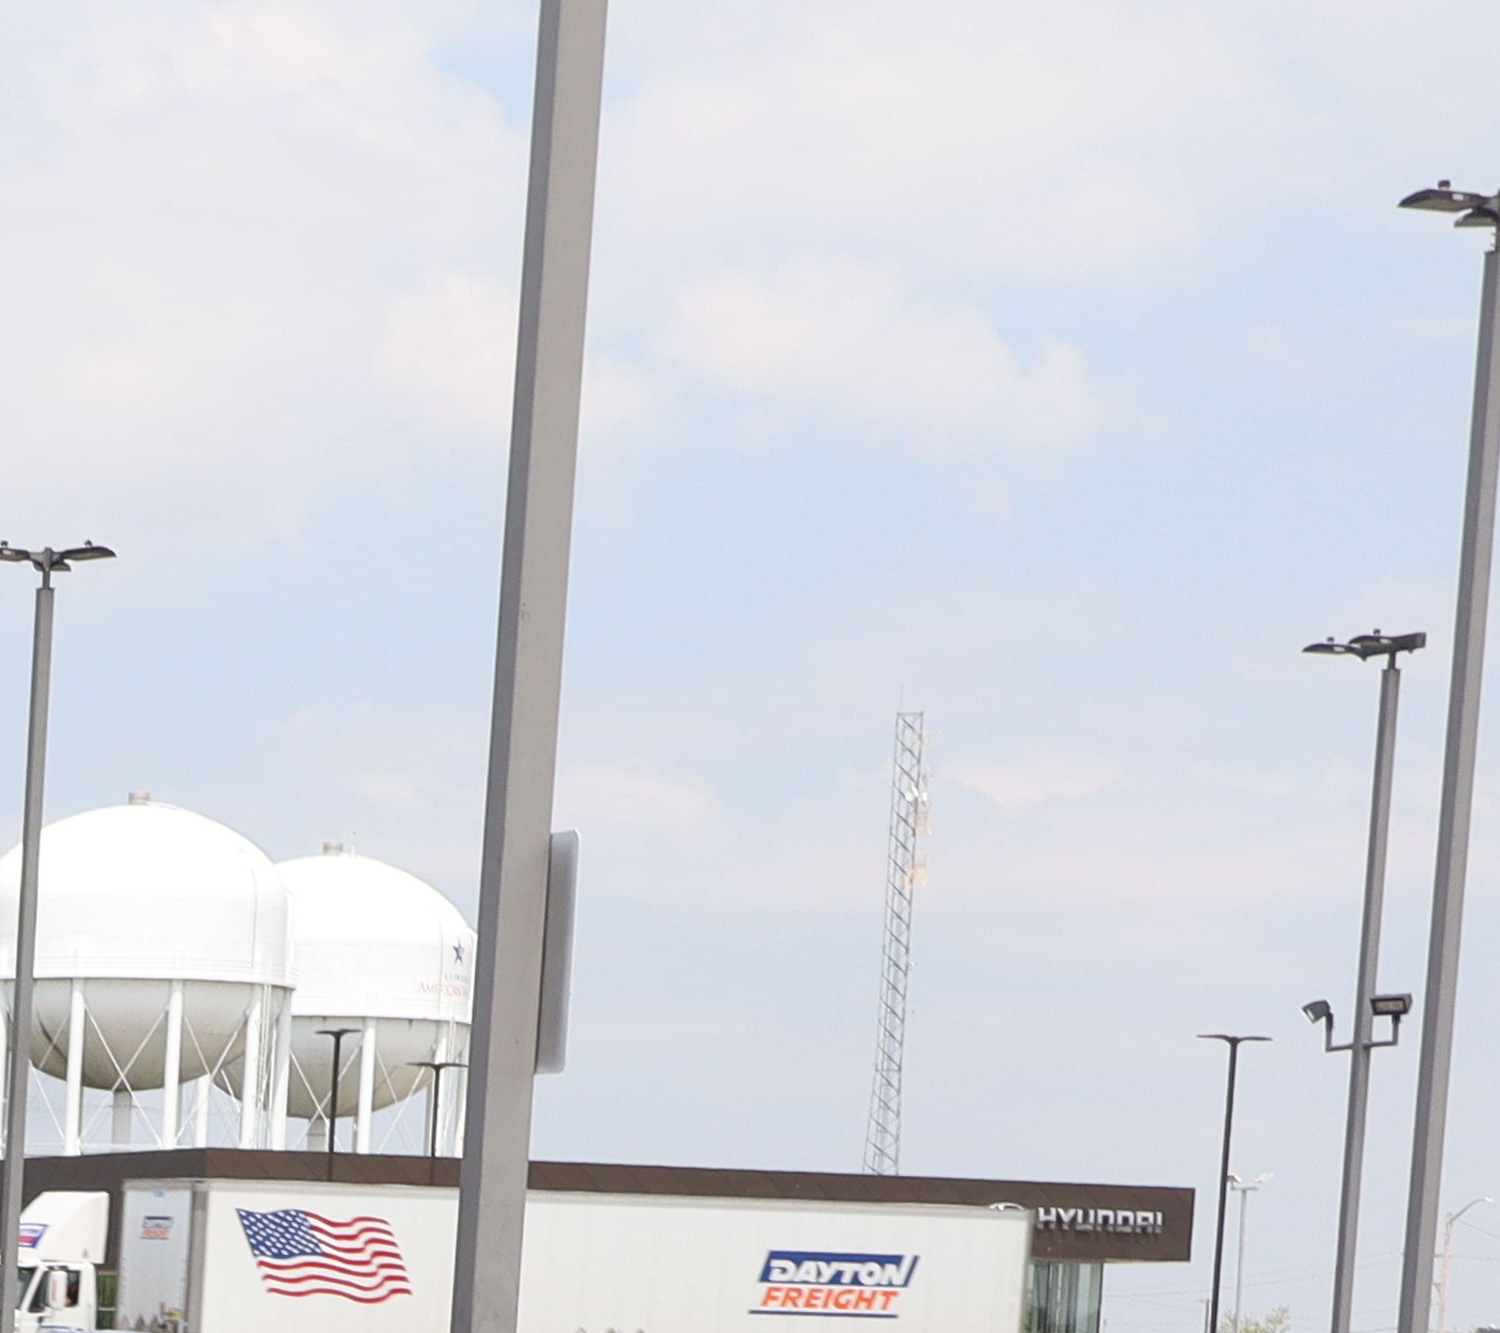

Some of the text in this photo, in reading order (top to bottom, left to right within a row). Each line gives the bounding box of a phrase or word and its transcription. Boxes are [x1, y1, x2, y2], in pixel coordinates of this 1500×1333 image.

[1037, 1207, 1163, 1234] HYUNDAI
[768, 1254, 914, 1286] DAYTON
[761, 1287, 899, 1310] FREIGHT
